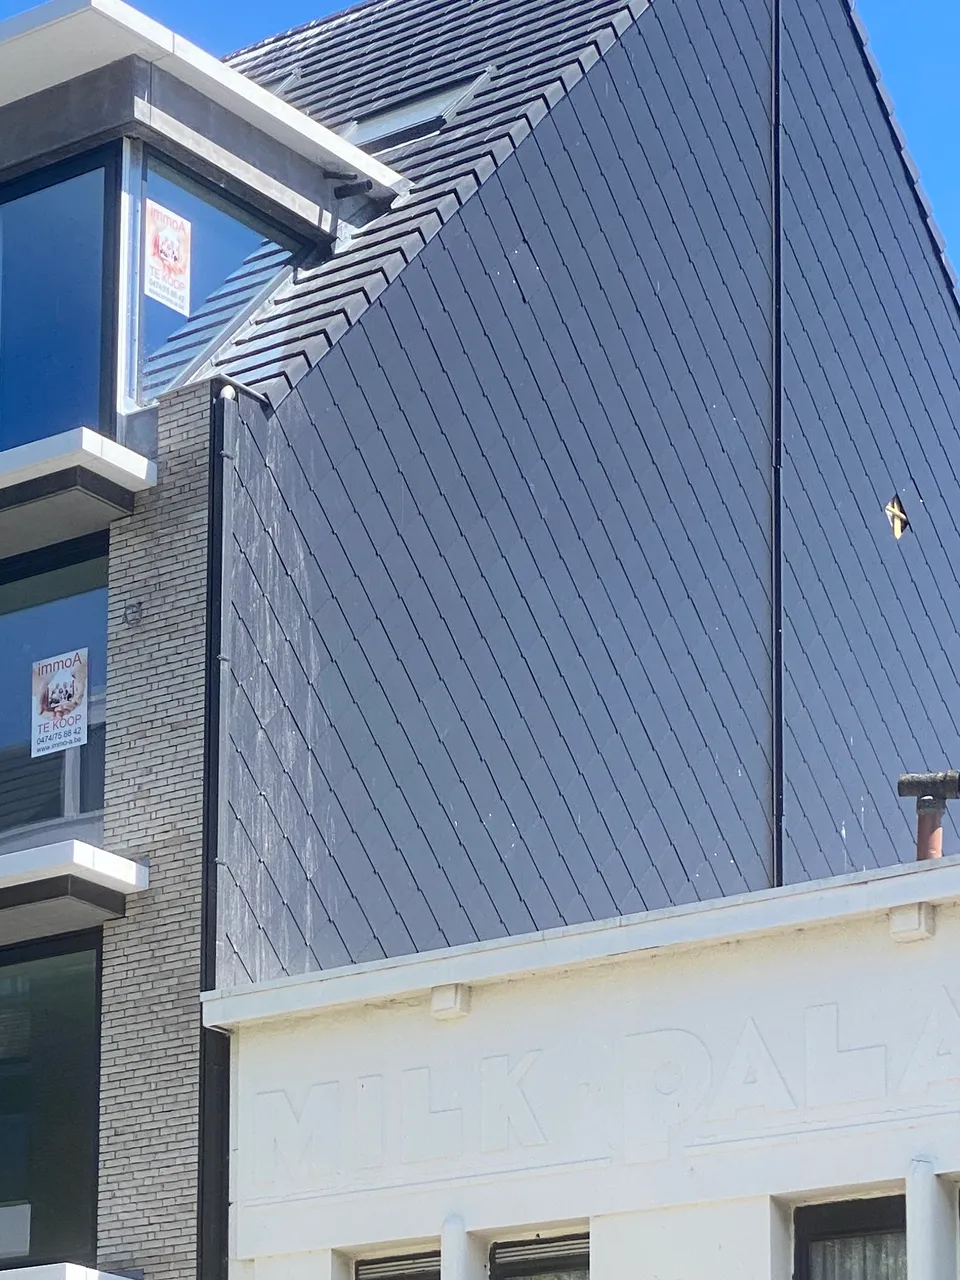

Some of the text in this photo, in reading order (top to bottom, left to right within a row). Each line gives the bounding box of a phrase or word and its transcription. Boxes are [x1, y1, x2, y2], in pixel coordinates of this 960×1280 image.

[150, 264, 185, 291] TE KOOP
[38, 652, 82, 676] immoA
[37, 731, 62, 745] 0474/75
[74, 727, 82, 735] 42
[38, 714, 82, 735] TE KOOP
[255, 1046, 547, 1187] MILK
